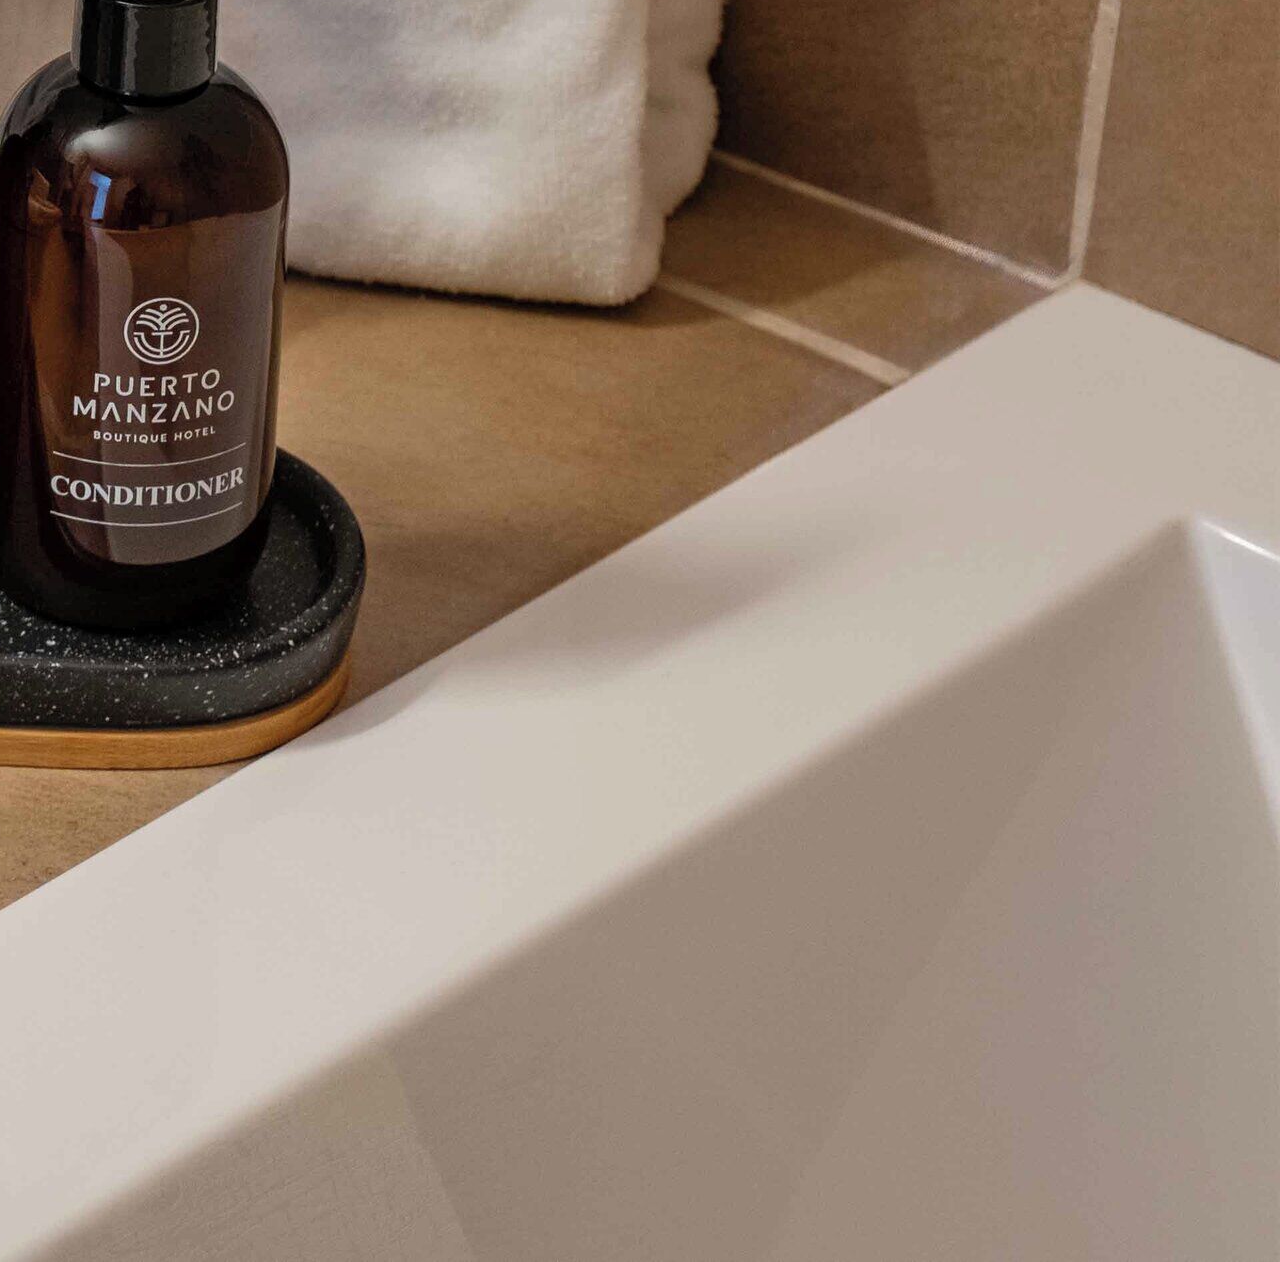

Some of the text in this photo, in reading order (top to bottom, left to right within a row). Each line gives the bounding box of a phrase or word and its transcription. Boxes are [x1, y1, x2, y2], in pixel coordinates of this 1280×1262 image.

[94, 368, 221, 397] PUERTO
[73, 390, 234, 424] MANZANO
[93, 425, 215, 444] BOUTIQUE HOTEL
[50, 467, 244, 506] CONDITIONER
